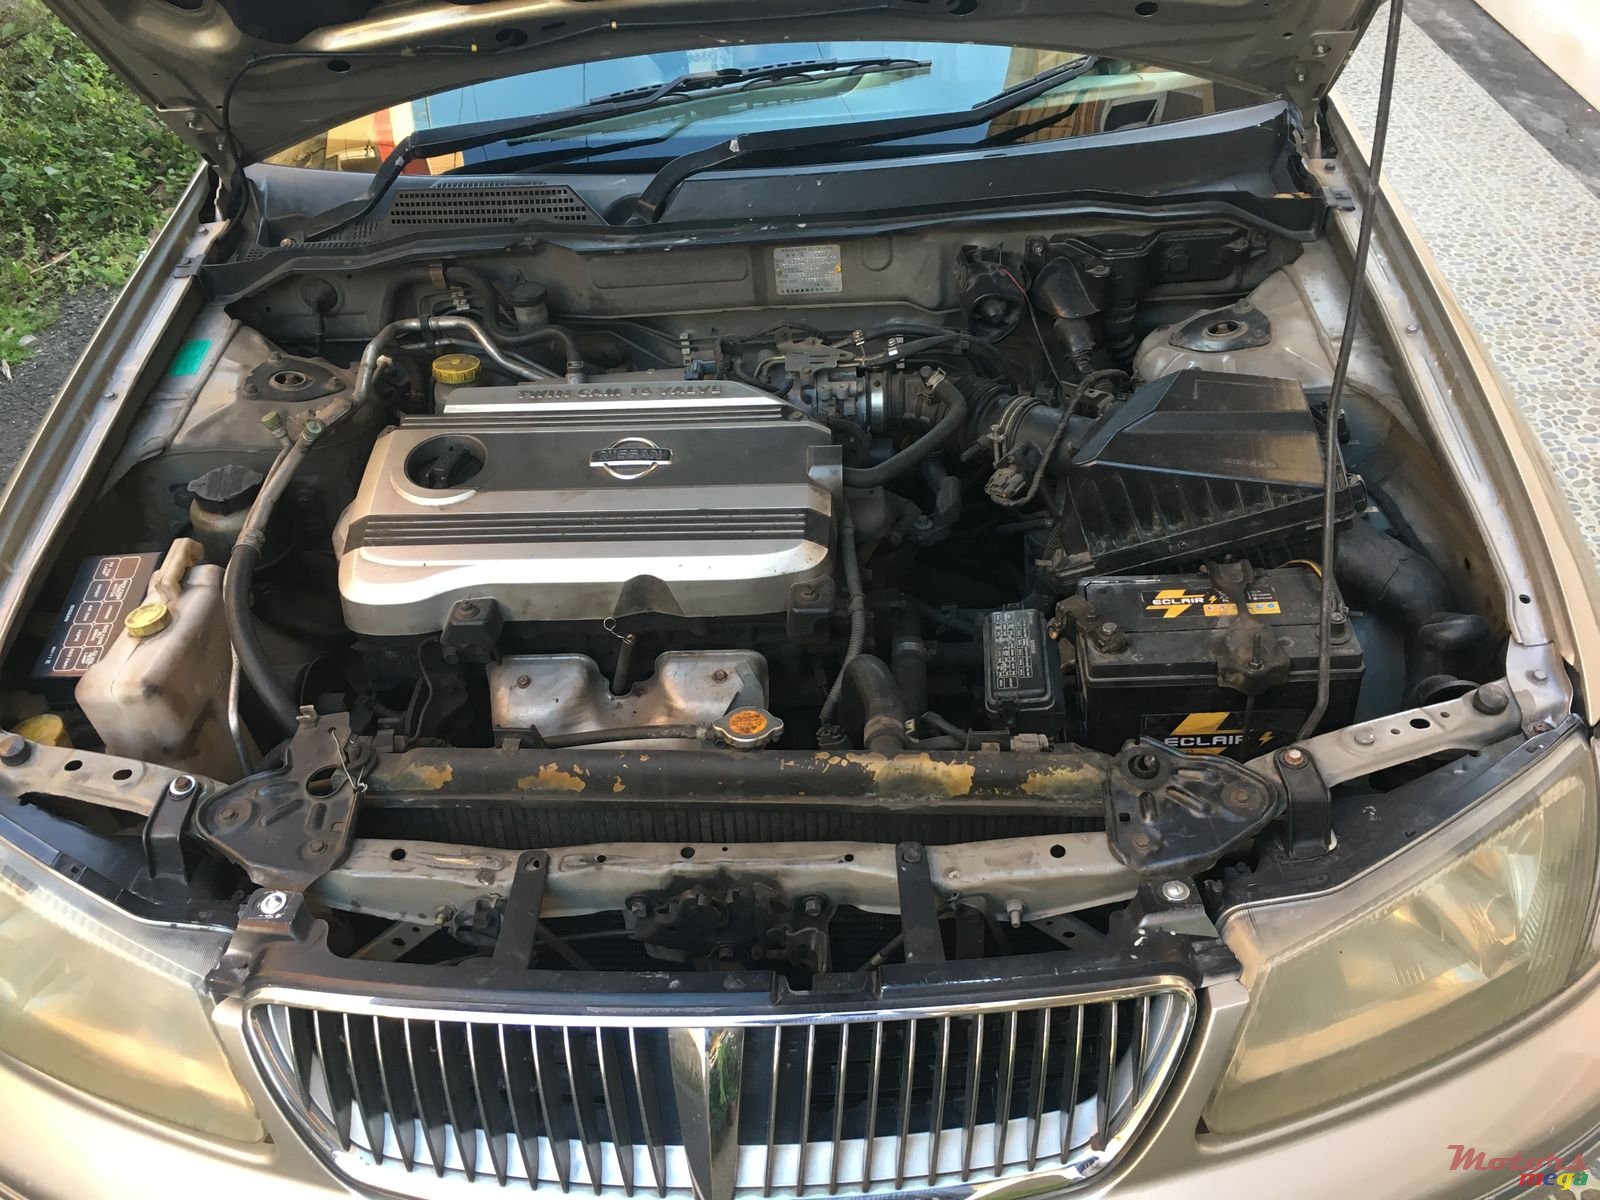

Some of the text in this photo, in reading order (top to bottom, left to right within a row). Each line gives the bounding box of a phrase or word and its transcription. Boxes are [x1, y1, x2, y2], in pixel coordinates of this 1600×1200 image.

[517, 385, 722, 399] TWIN CAM 16 VALVE
[599, 449, 663, 461] NISSAN
[1152, 597, 1205, 605] ECLAIR
